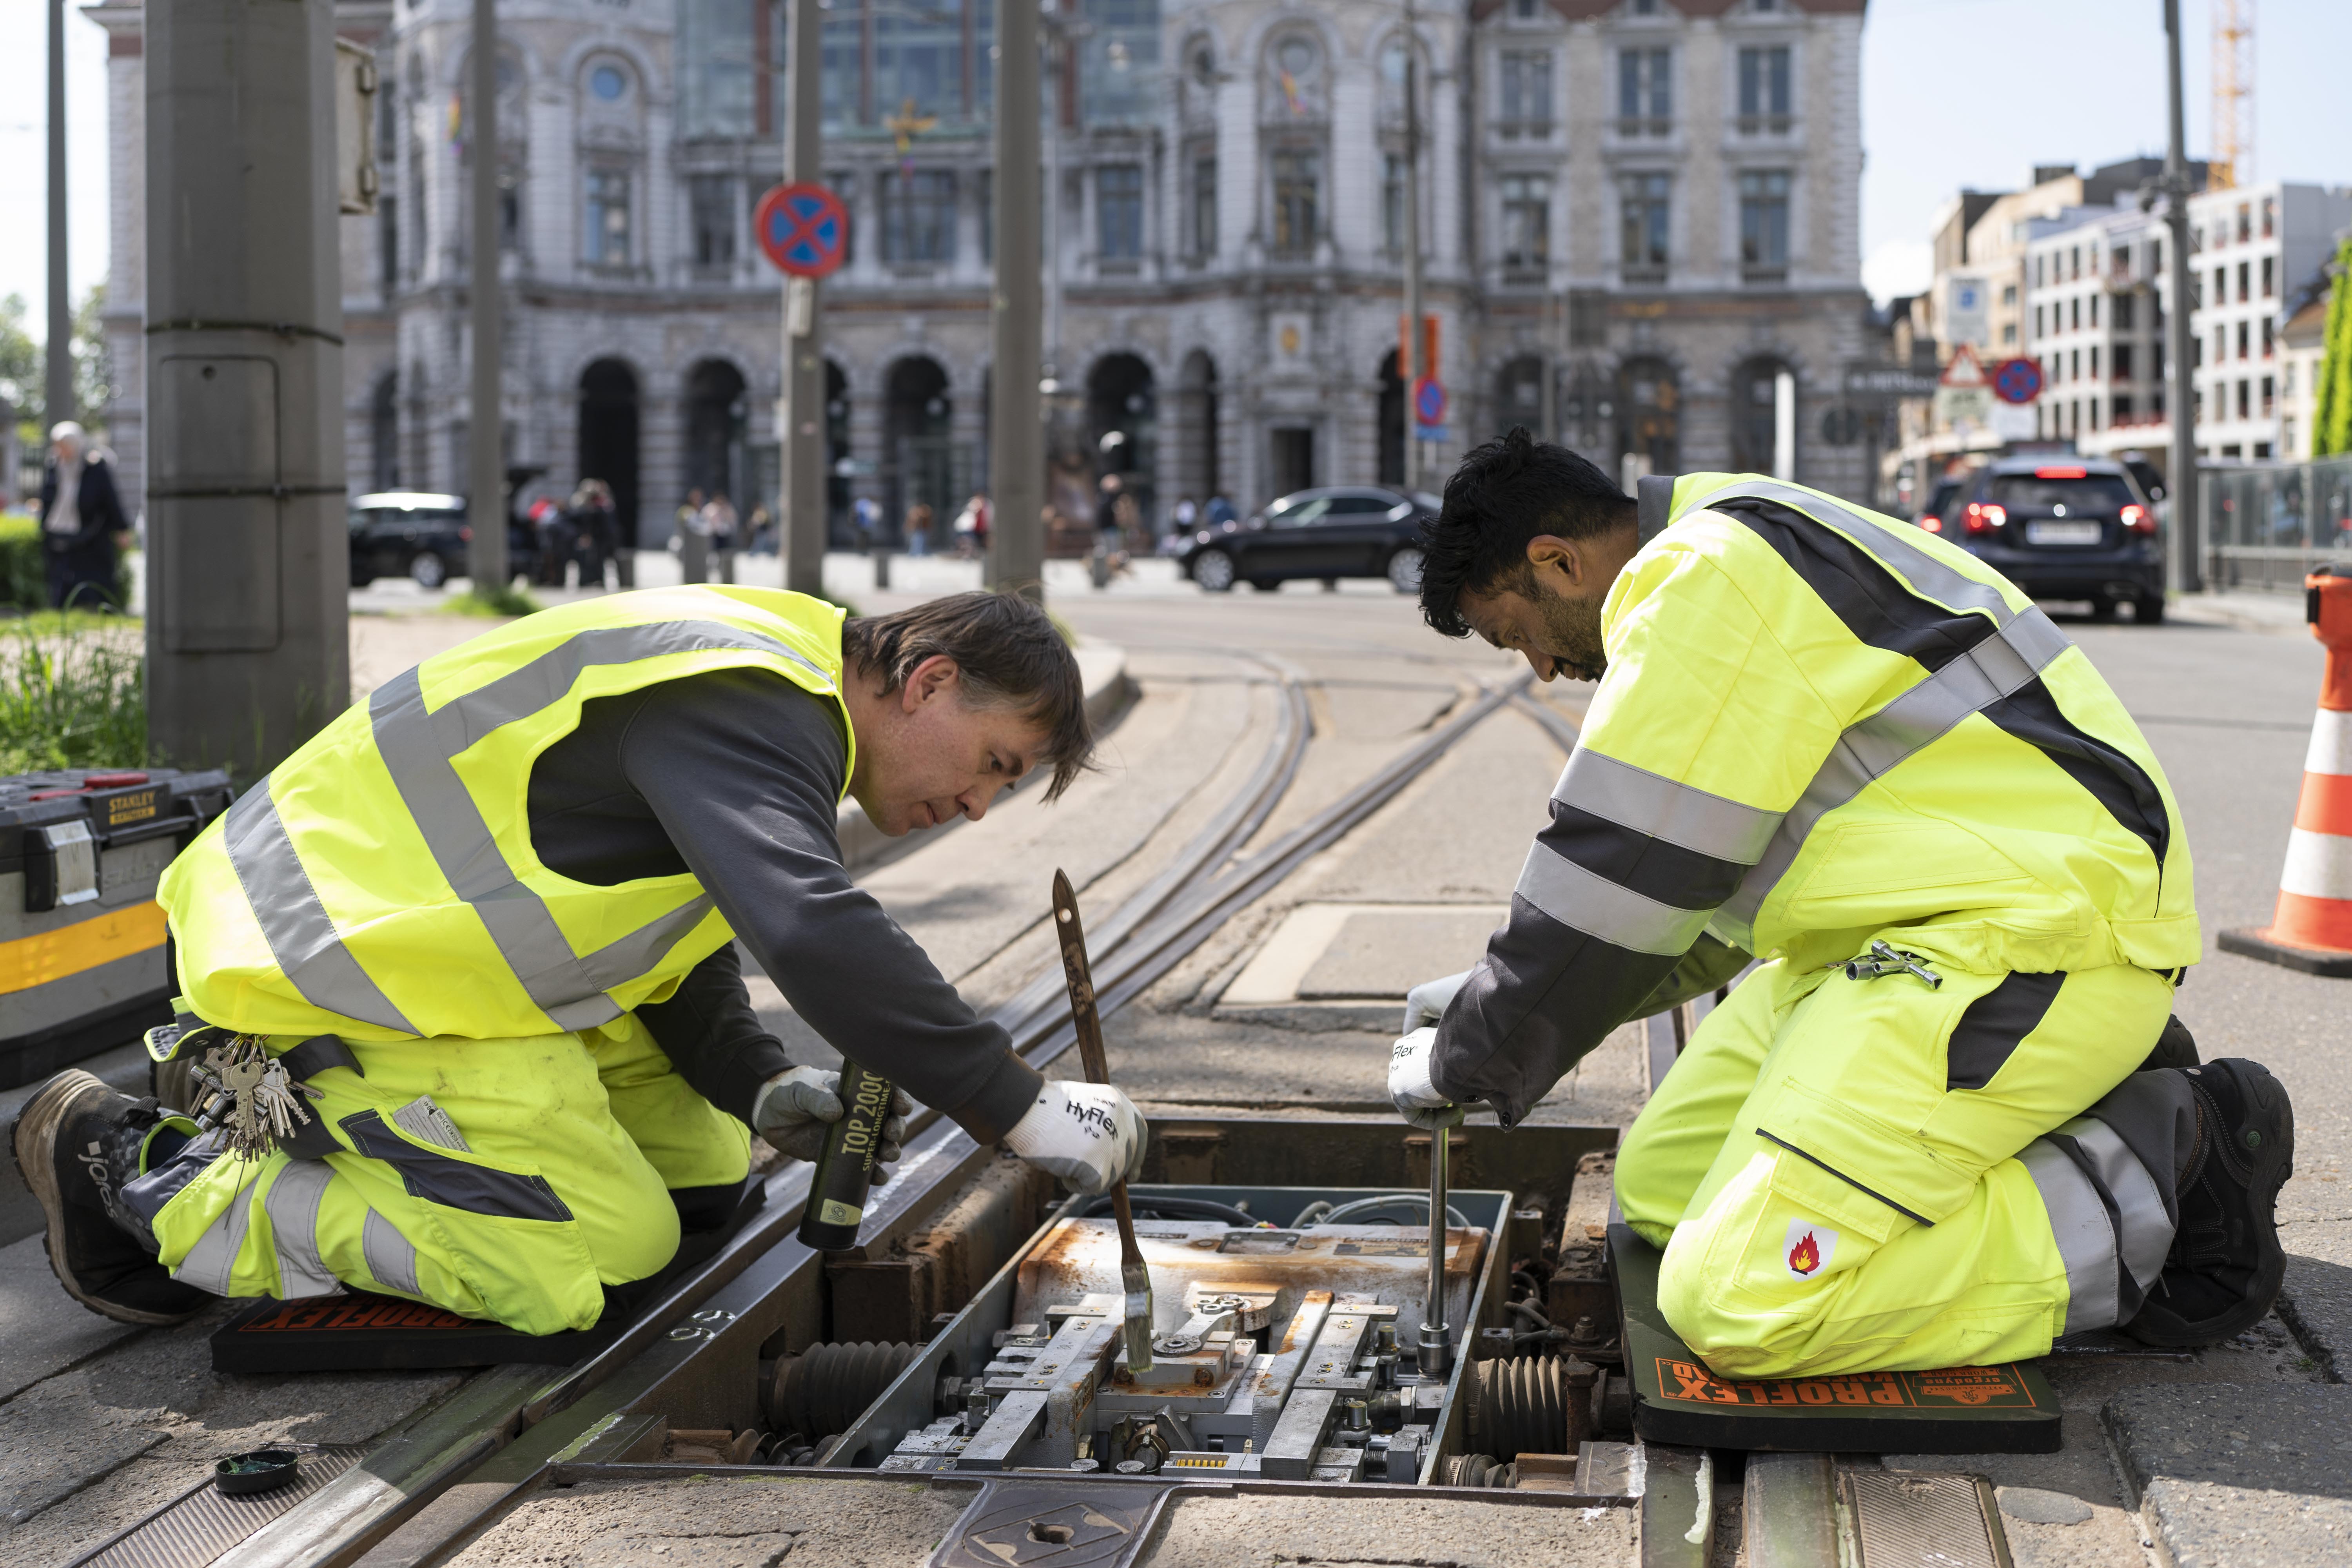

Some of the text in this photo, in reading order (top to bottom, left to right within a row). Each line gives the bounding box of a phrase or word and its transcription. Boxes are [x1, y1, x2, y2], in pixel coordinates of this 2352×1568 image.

[109, 791, 156, 813] STANLEY
[1391, 1045, 1415, 1062] Flex
[1066, 1100, 1118, 1141] HyFlex
[841, 1119, 871, 1154] TOP
[78, 1154, 118, 1218] jalas
[258, 1305, 461, 1328] PROFLEX
[1675, 1377, 1905, 1405] PROFLEX
[1925, 1376, 2000, 1385] ergodyne
